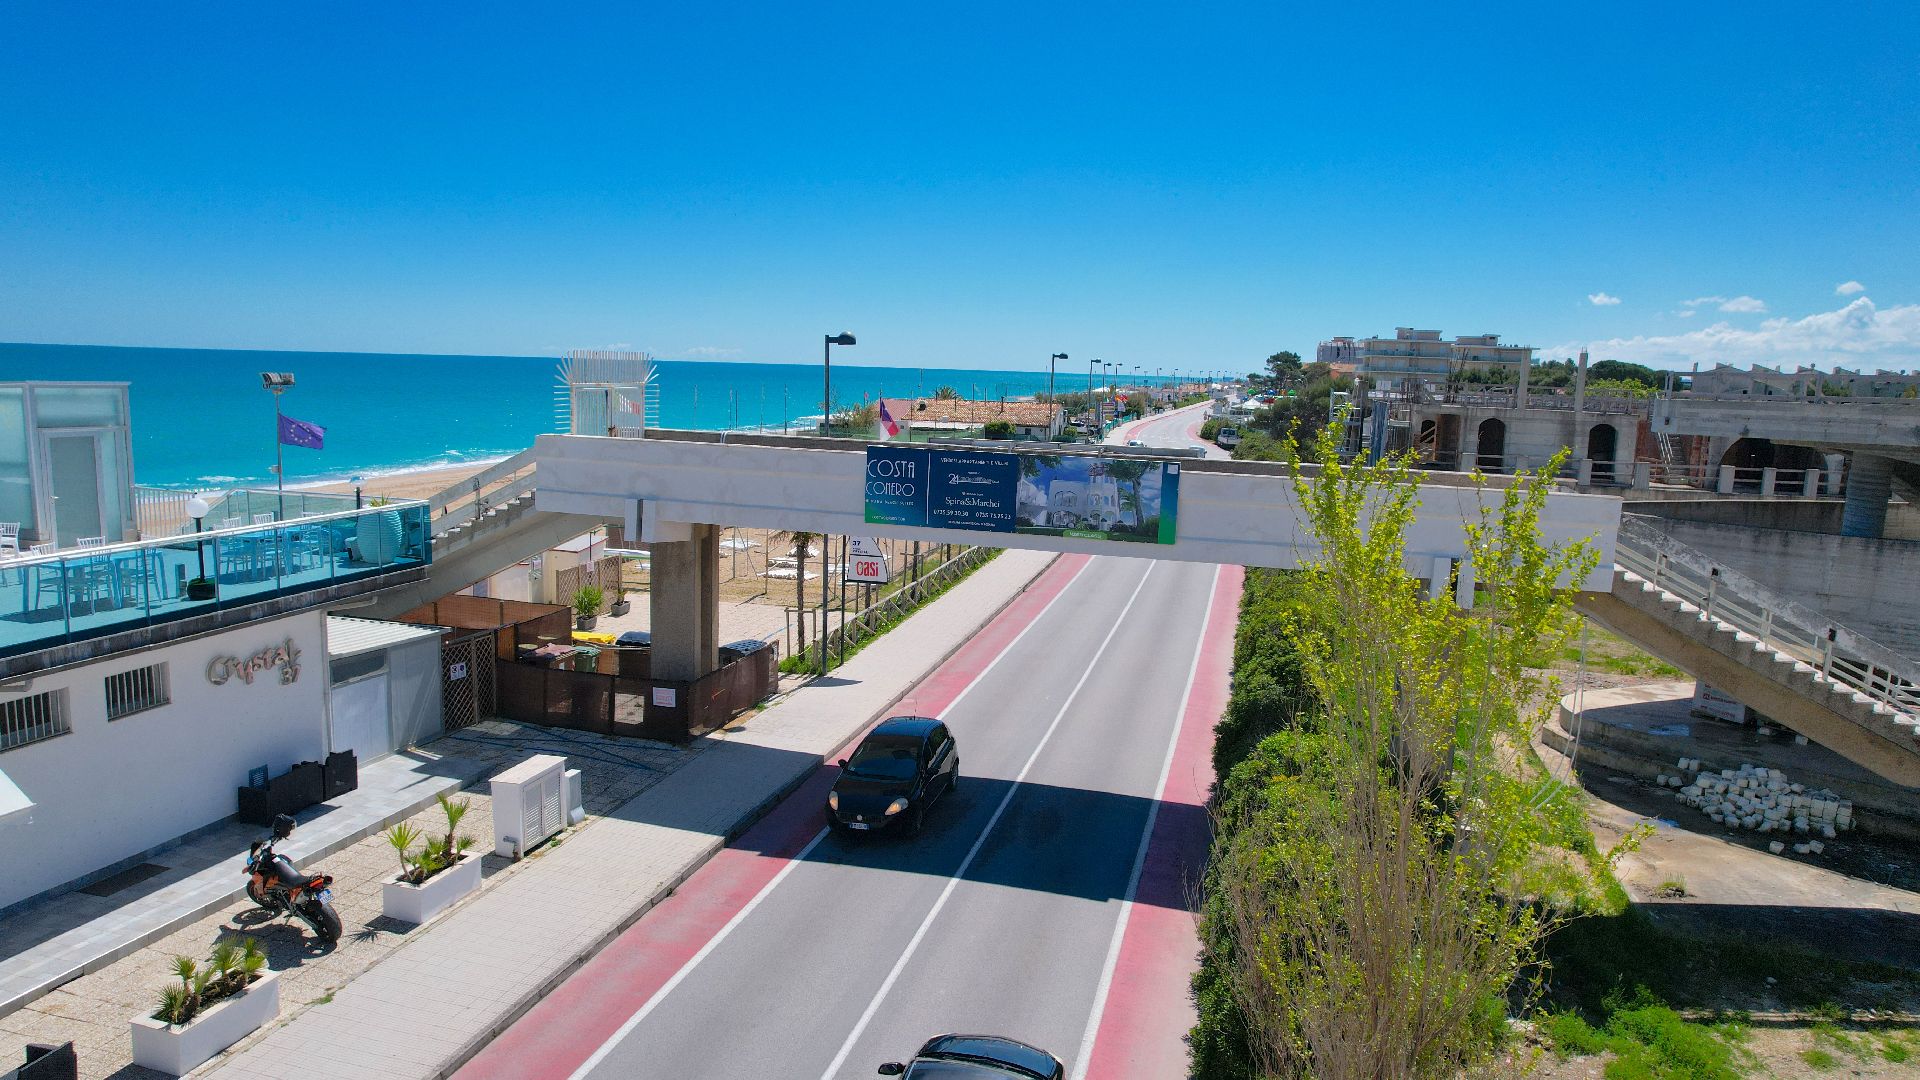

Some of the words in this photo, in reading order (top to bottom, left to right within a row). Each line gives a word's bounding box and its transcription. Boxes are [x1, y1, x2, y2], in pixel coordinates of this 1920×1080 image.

[867, 459, 915, 479] COSTA
[865, 481, 915, 497] CONERO
[206, 637, 302, 685] Crystal
